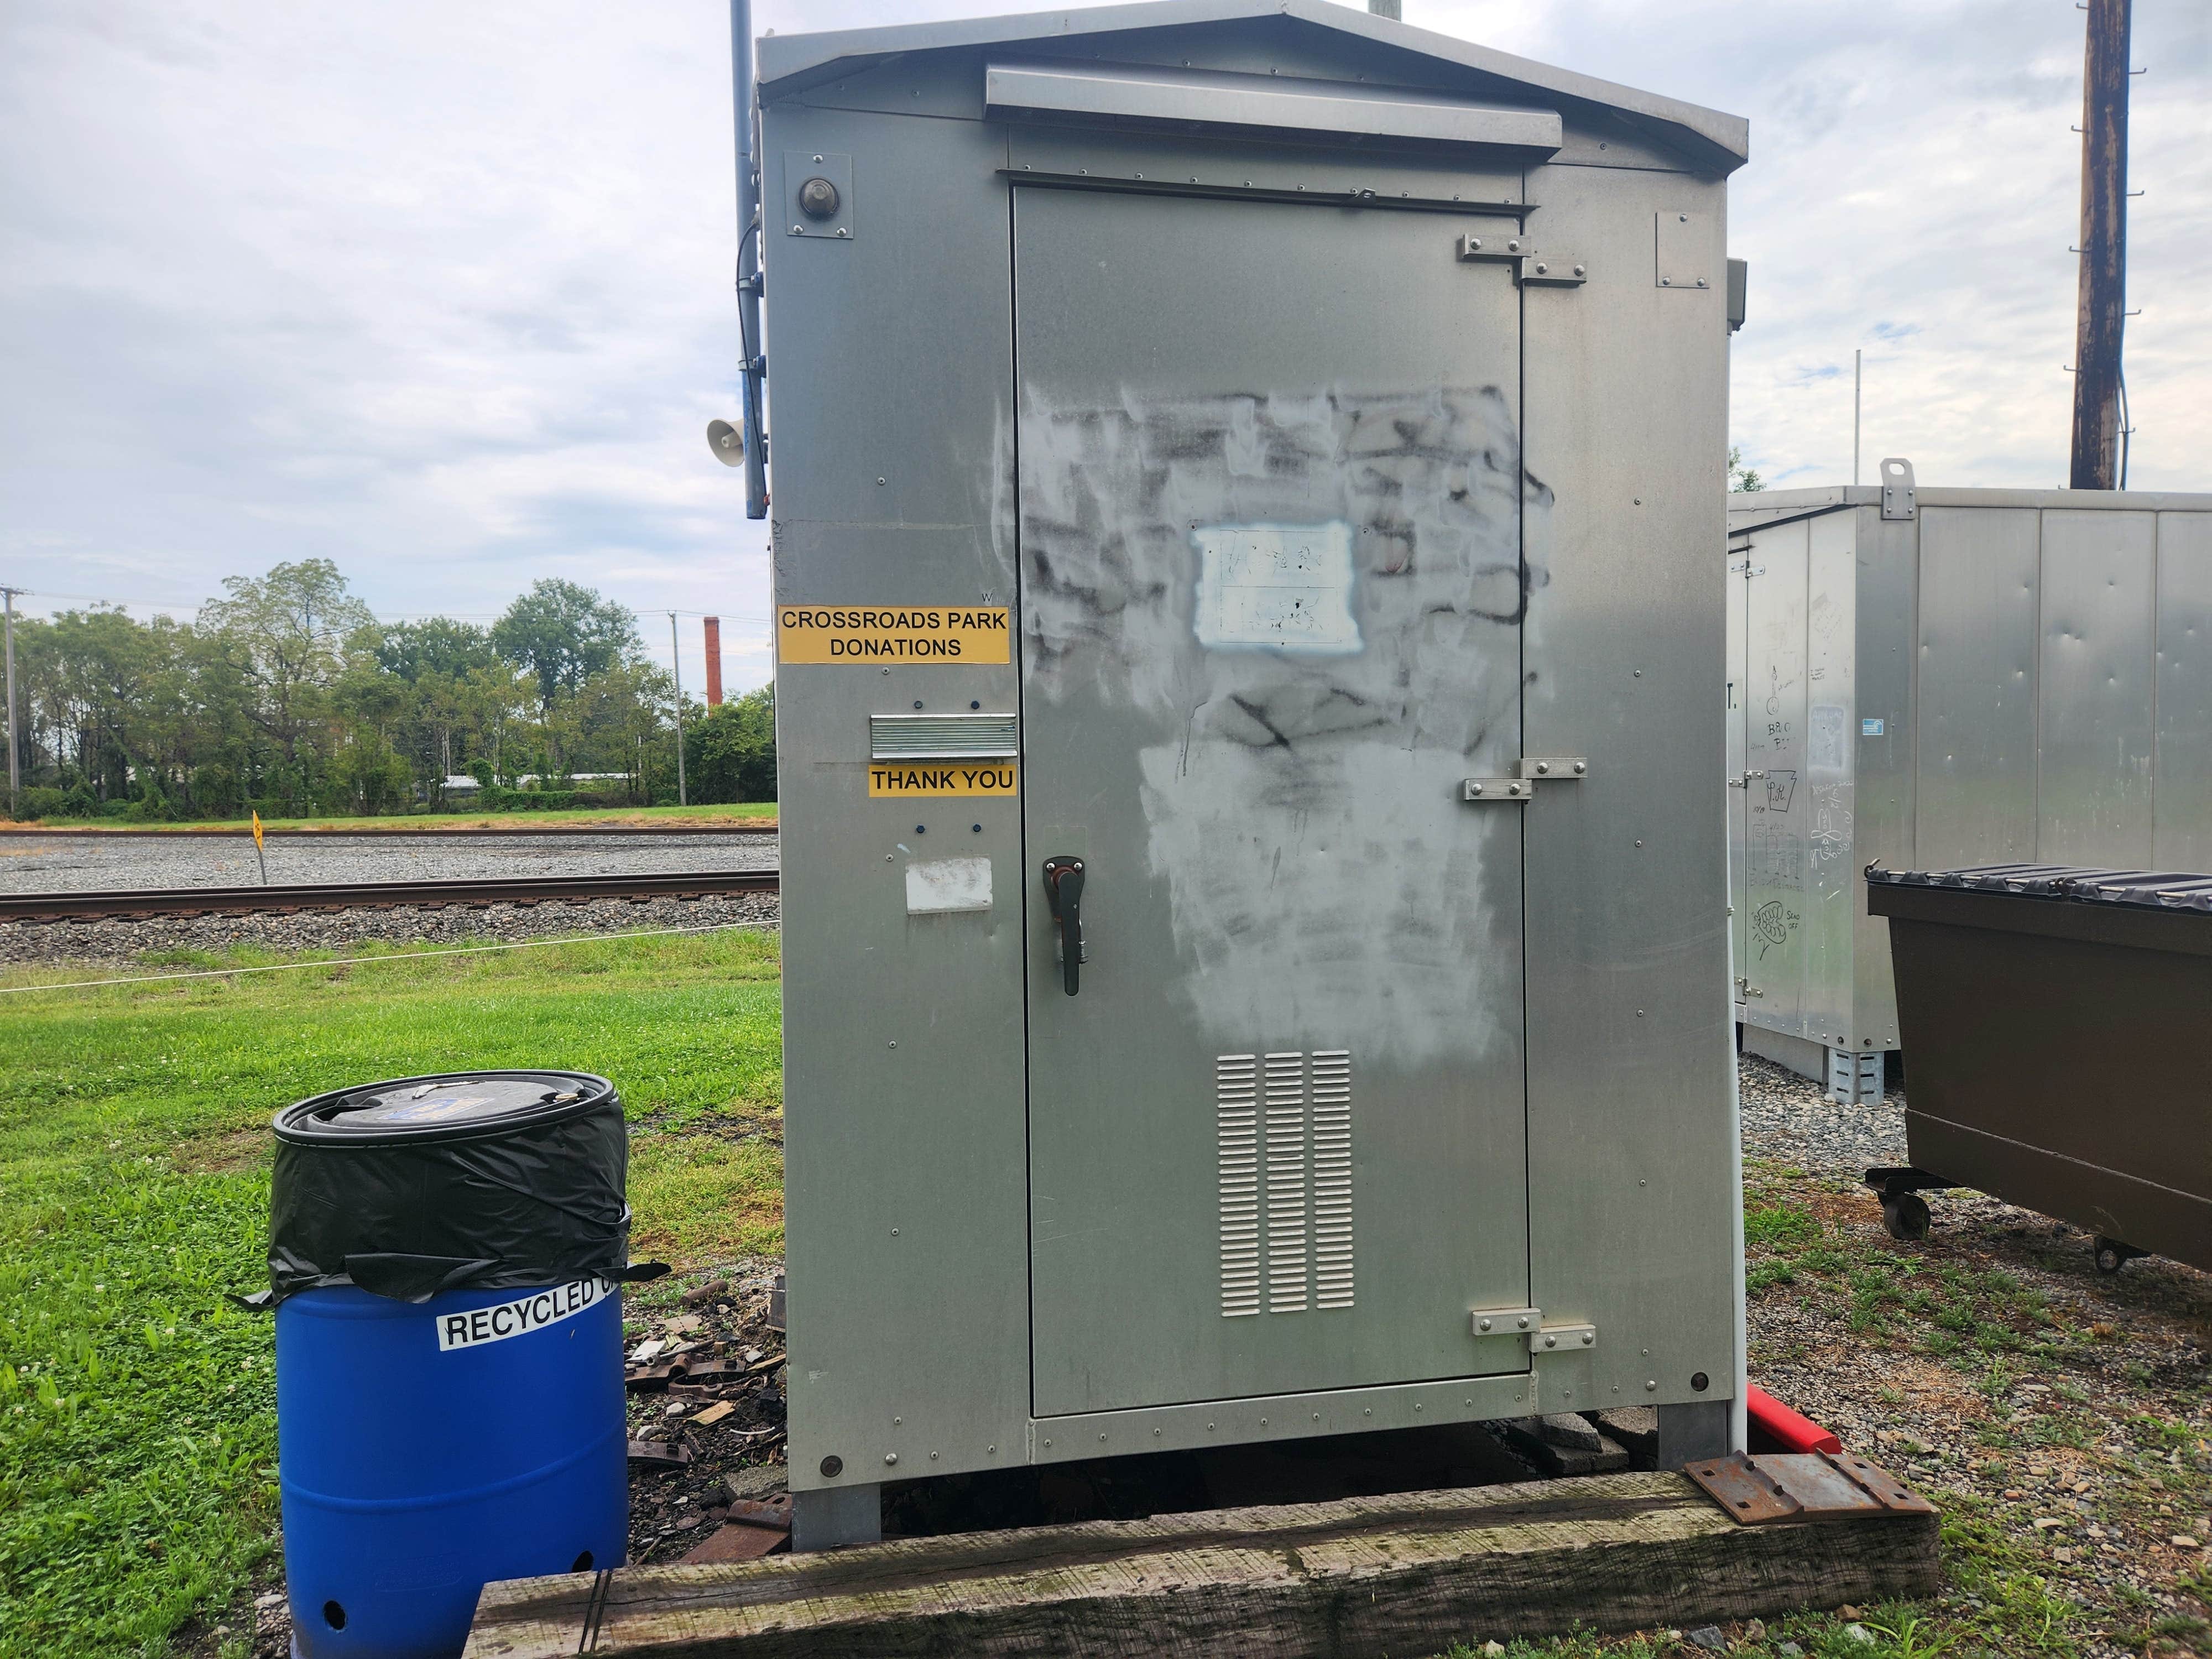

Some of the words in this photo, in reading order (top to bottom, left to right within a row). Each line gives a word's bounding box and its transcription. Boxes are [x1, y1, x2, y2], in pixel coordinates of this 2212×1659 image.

[781, 611, 941, 629] CROSSROADS
[948, 612, 1007, 629] PARK
[831, 639, 962, 656] DONATIONS
[871, 770, 956, 789] THANK
[962, 770, 1013, 789] YOU
[446, 1278, 594, 1346] RECYCLED
